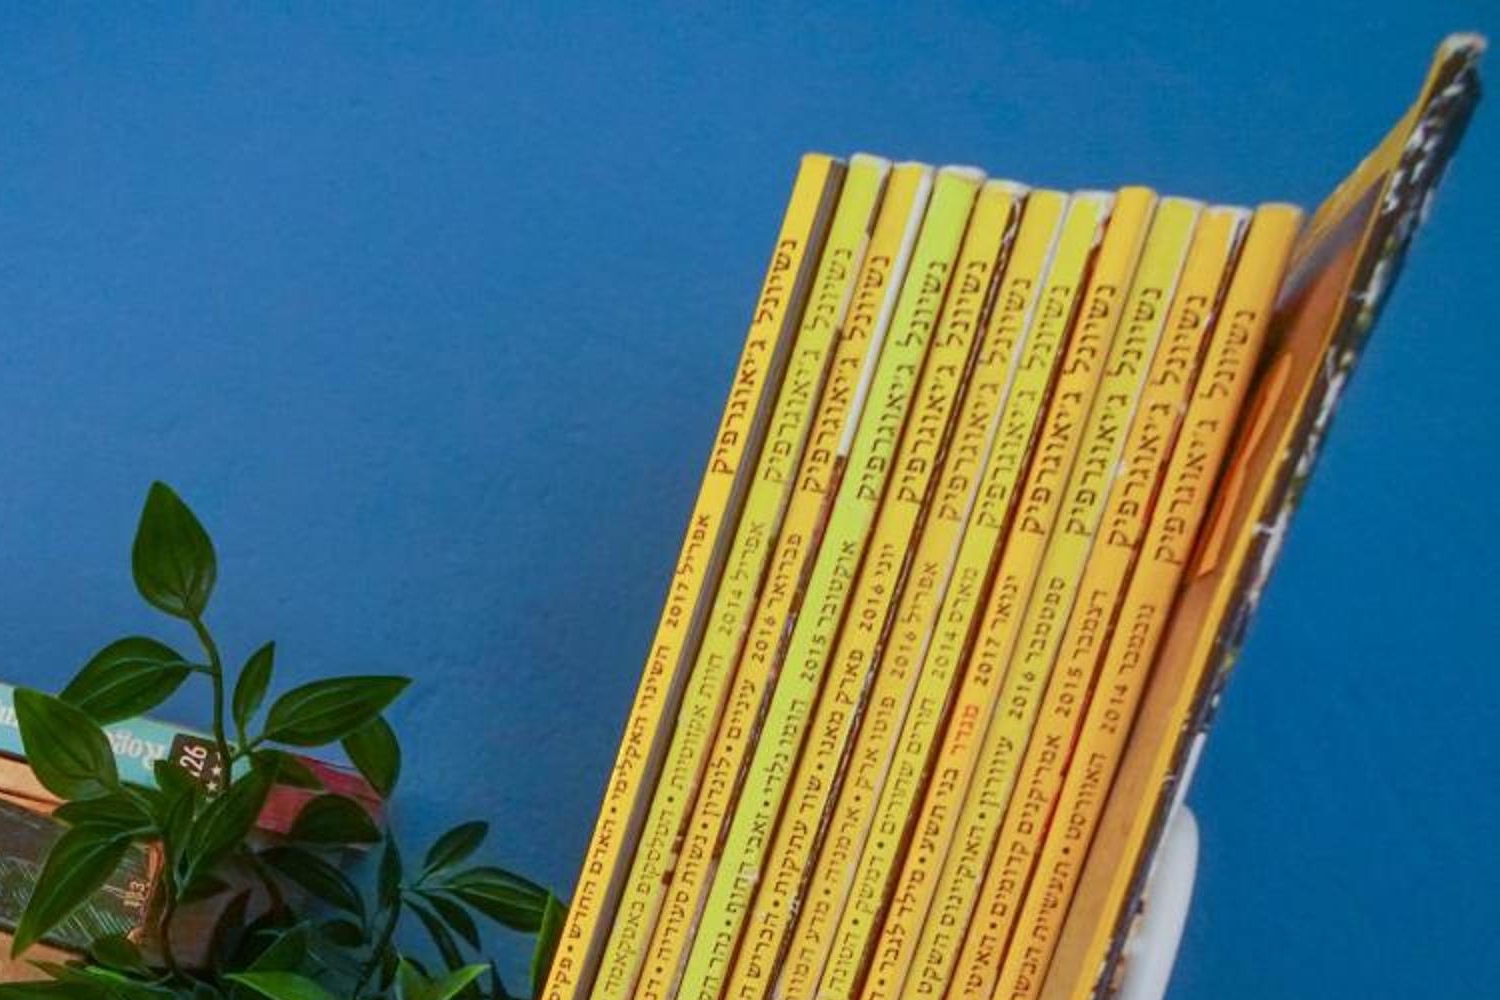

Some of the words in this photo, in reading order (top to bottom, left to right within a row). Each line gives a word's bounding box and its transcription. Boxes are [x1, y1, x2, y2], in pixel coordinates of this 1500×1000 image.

[753, 236, 797, 324] נשיונל
[803, 248, 852, 330] נשיונל
[842, 251, 890, 341] נשיונל
[896, 260, 948, 347] נשיונל
[936, 260, 987, 346] נשיונל
[978, 271, 1031, 365] נשיונל
[1018, 285, 1070, 371] נשיונל
[1064, 284, 1116, 374] נשיונל
[1105, 282, 1162, 377] נשיונל
[1150, 295, 1207, 386] נשיונל
[1200, 309, 1256, 399] נשיונל
[766, 533, 802, 606] פברואר
[874, 543, 894, 575] יוני
[665, 581, 688, 628] 2017
[858, 583, 884, 632] 2016
[990, 575, 1018, 629] ינואר
[1024, 577, 1065, 662] ספטמבר
[1073, 589, 1107, 659] דצמבר
[750, 615, 776, 663] 2016
[800, 633, 826, 683] 2015
[974, 636, 999, 686] 2017
[834, 648, 864, 705] פארק
[1007, 671, 1035, 720] 2016
[1055, 667, 1083, 718] 2015
[726, 678, 755, 740] עיניים
[817, 710, 844, 755] מאנו
[950, 703, 979, 754] מגדר
[1099, 684, 1128, 734] 2014
[701, 756, 730, 817] לונדון
[798, 774, 822, 813] שוד
[936, 768, 959, 796] בני
[978, 735, 1014, 807] עיוורון
[1017, 735, 1061, 834] אמריקנים
[773, 819, 808, 896] עתיקות
[919, 804, 946, 853] תשע
[680, 834, 708, 886] נשות
[939, 825, 984, 926] האוקיינוס
[989, 840, 1028, 917] קדומים
[896, 869, 925, 916] מילד
[656, 890, 689, 960] סעודיה
[746, 911, 779, 979] הכריש
[878, 923, 906, 971] לגבר
[916, 932, 949, 994] השקט
[963, 934, 996, 994] האיטי
